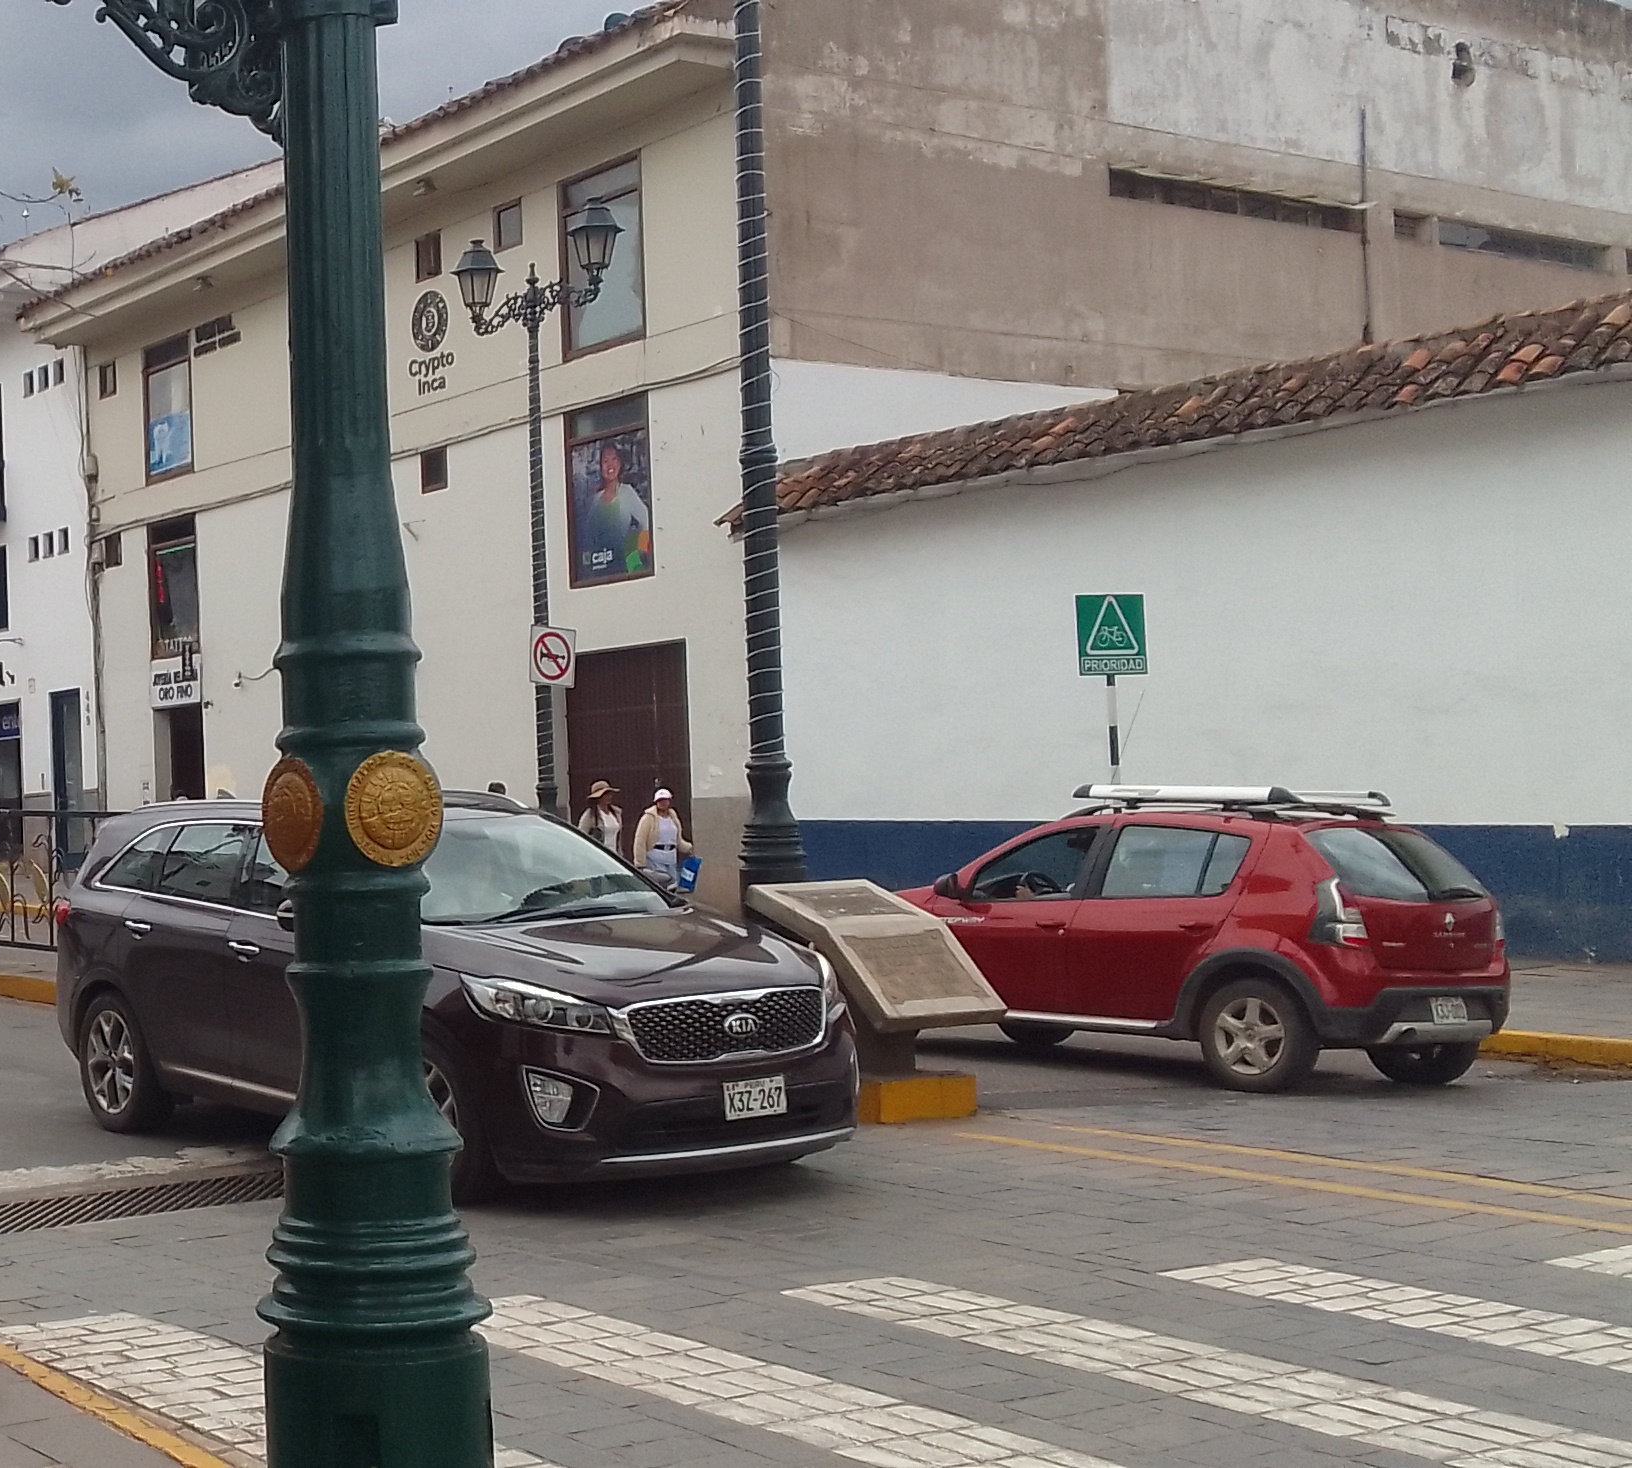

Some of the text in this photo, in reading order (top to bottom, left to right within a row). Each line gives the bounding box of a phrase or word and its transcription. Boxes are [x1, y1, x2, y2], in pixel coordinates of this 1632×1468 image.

[409, 350, 455, 378] Crypto
[417, 375, 446, 396] Inca
[591, 547, 613, 564] caja
[1084, 659, 1143, 671] PRIORIDAD
[158, 686, 175, 701] ORO
[731, 1018, 756, 1033] KIA
[727, 1086, 783, 1114] X3Z-267
